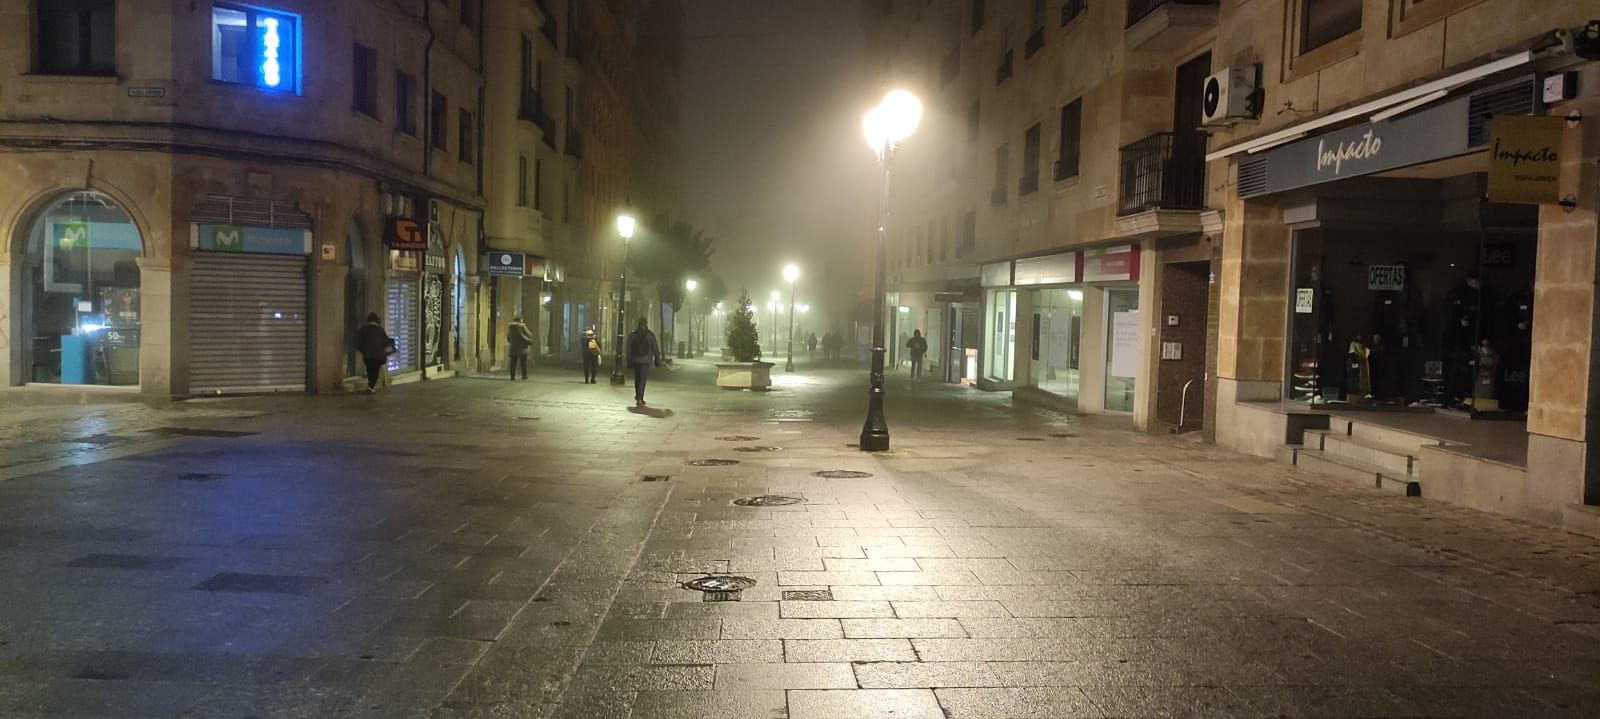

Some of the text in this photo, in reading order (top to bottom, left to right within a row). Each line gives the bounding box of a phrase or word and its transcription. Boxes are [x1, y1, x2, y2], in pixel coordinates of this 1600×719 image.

[1317, 129, 1382, 175] Impacto
[1494, 137, 1558, 167] Impacto
[1481, 247, 1512, 264] Lee
[1370, 266, 1403, 286] OFERTAS
[1503, 368, 1527, 383] Lee
